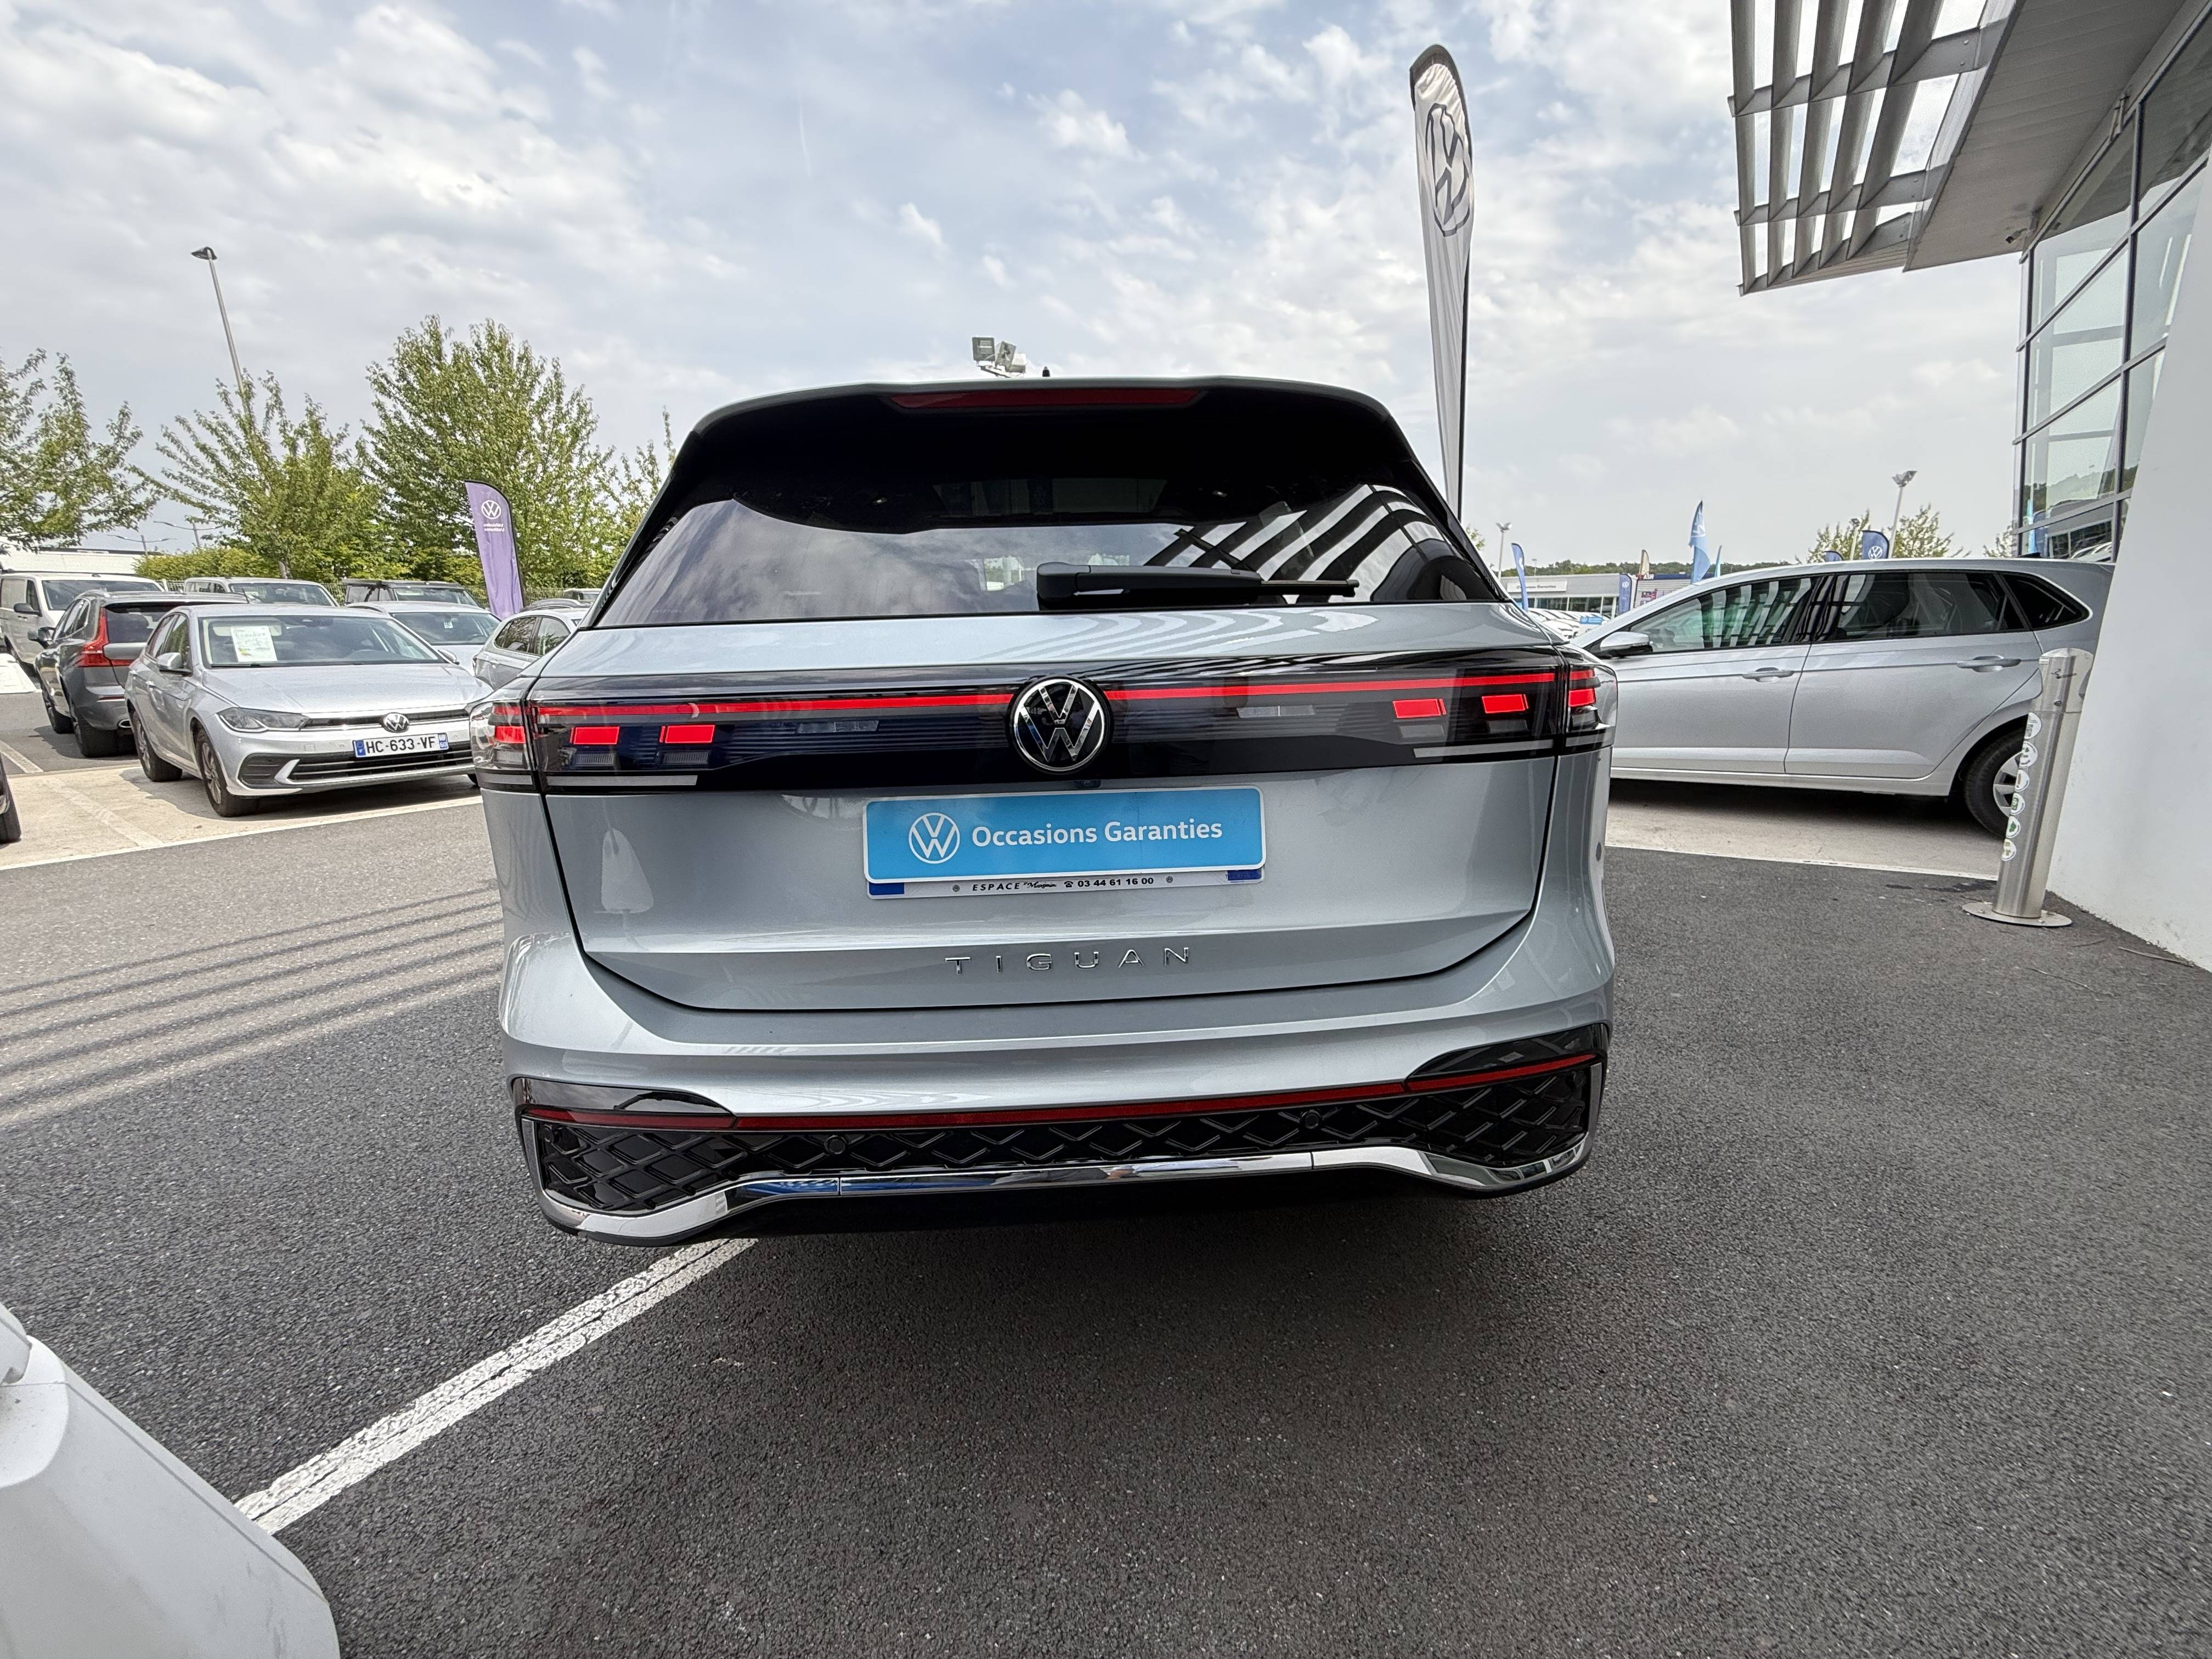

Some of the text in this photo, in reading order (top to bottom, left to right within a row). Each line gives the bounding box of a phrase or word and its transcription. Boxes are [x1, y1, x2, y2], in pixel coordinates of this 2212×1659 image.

[366, 736, 435, 754] HC-633-VF
[972, 823, 1097, 847] Occasions
[1105, 818, 1223, 843] Garanties
[972, 882, 1020, 891] ESPACE
[945, 947, 1189, 975] TIGUAN
